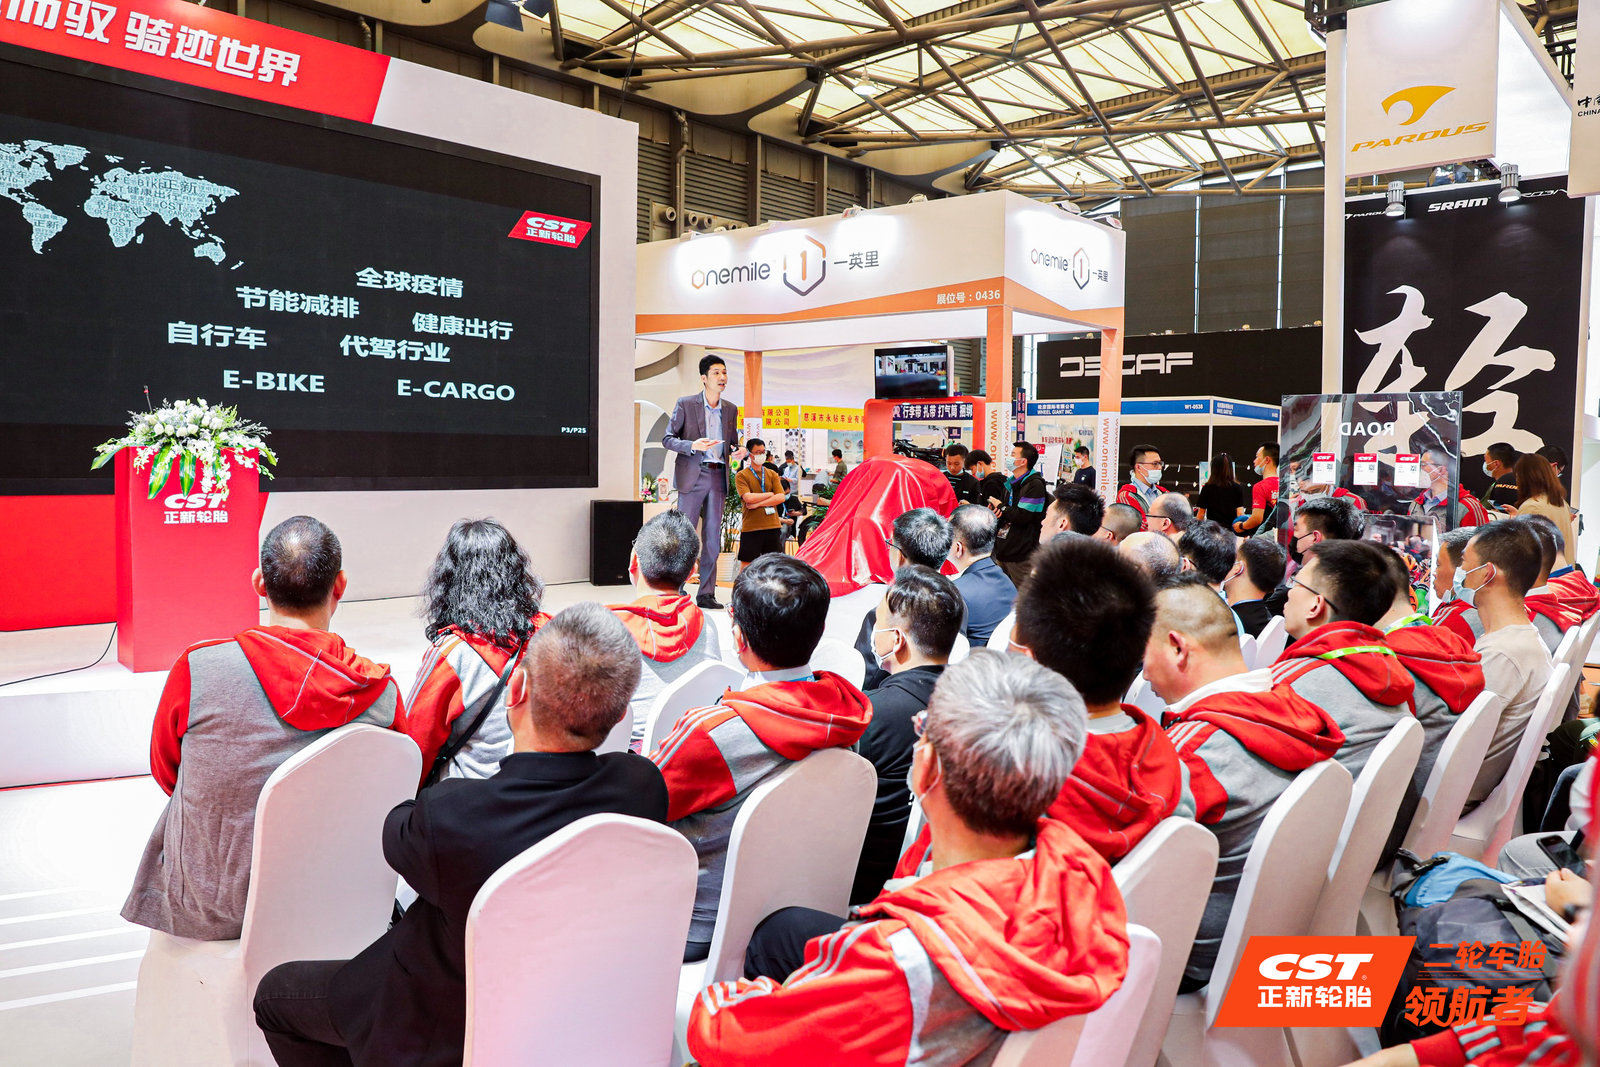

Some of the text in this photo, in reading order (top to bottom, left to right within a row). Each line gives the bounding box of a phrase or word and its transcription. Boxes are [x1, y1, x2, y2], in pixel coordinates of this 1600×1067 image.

[124, 11, 300, 87] 骑迹世界
[1351, 121, 1490, 152] PARDUS
[1427, 197, 1489, 212] SRAM
[526, 216, 577, 233] CST
[833, 250, 880, 270] 一英里
[355, 266, 464, 299] 全球疫情
[235, 285, 360, 319] 节能减排
[167, 320, 268, 350] 自行车
[411, 312, 514, 340] 健康出行
[339, 334, 451, 363] 代驾行业
[223, 369, 326, 393] E-BIKE
[397, 378, 515, 401] E-CARGO
[903, 404, 922, 418] 行李带
[938, 404, 958, 418] 打气筒
[561, 426, 587, 434] P3/P25
[164, 493, 224, 509] CST
[164, 510, 228, 524] 正新轮胎
